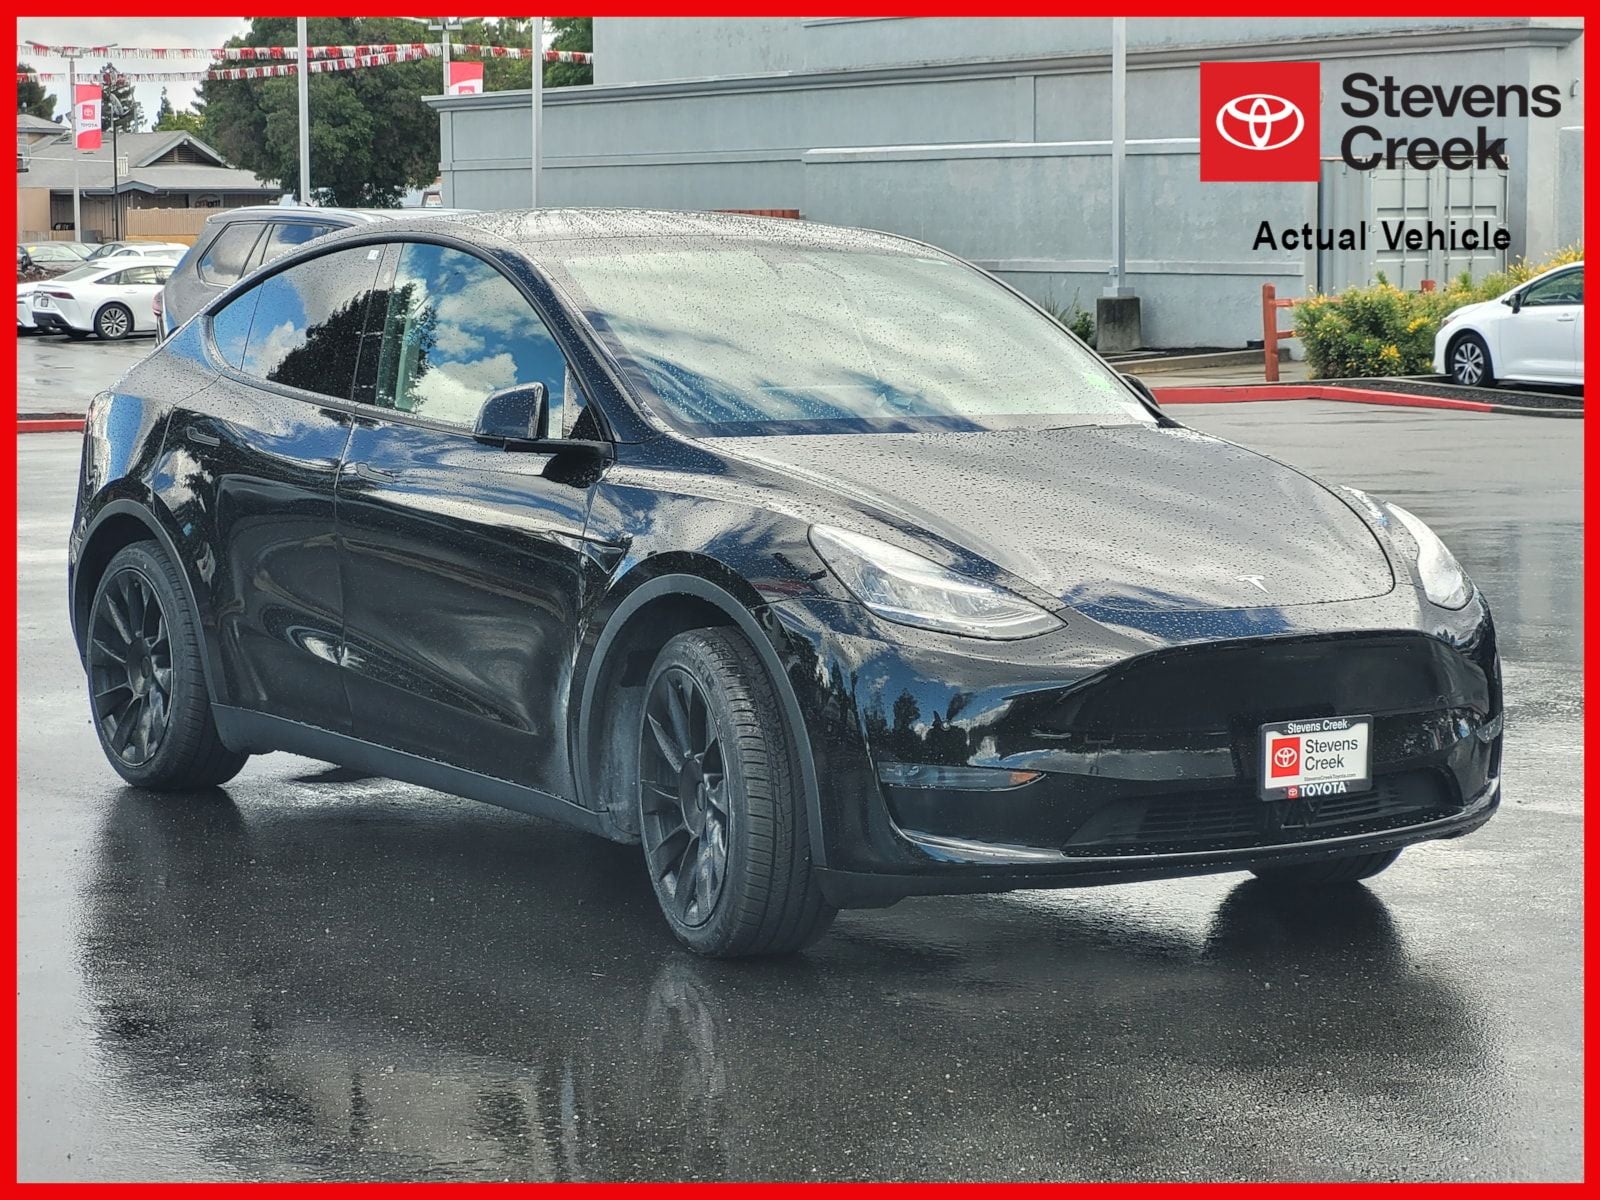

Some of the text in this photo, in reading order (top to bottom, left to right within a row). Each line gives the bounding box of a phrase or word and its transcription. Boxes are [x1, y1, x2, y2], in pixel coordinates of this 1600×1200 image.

[1287, 718, 1348, 734] Stevens Creek
[1304, 739, 1359, 754] Stevens
[1304, 754, 1345, 771] Creek
[1299, 781, 1347, 797] TOYOTA
